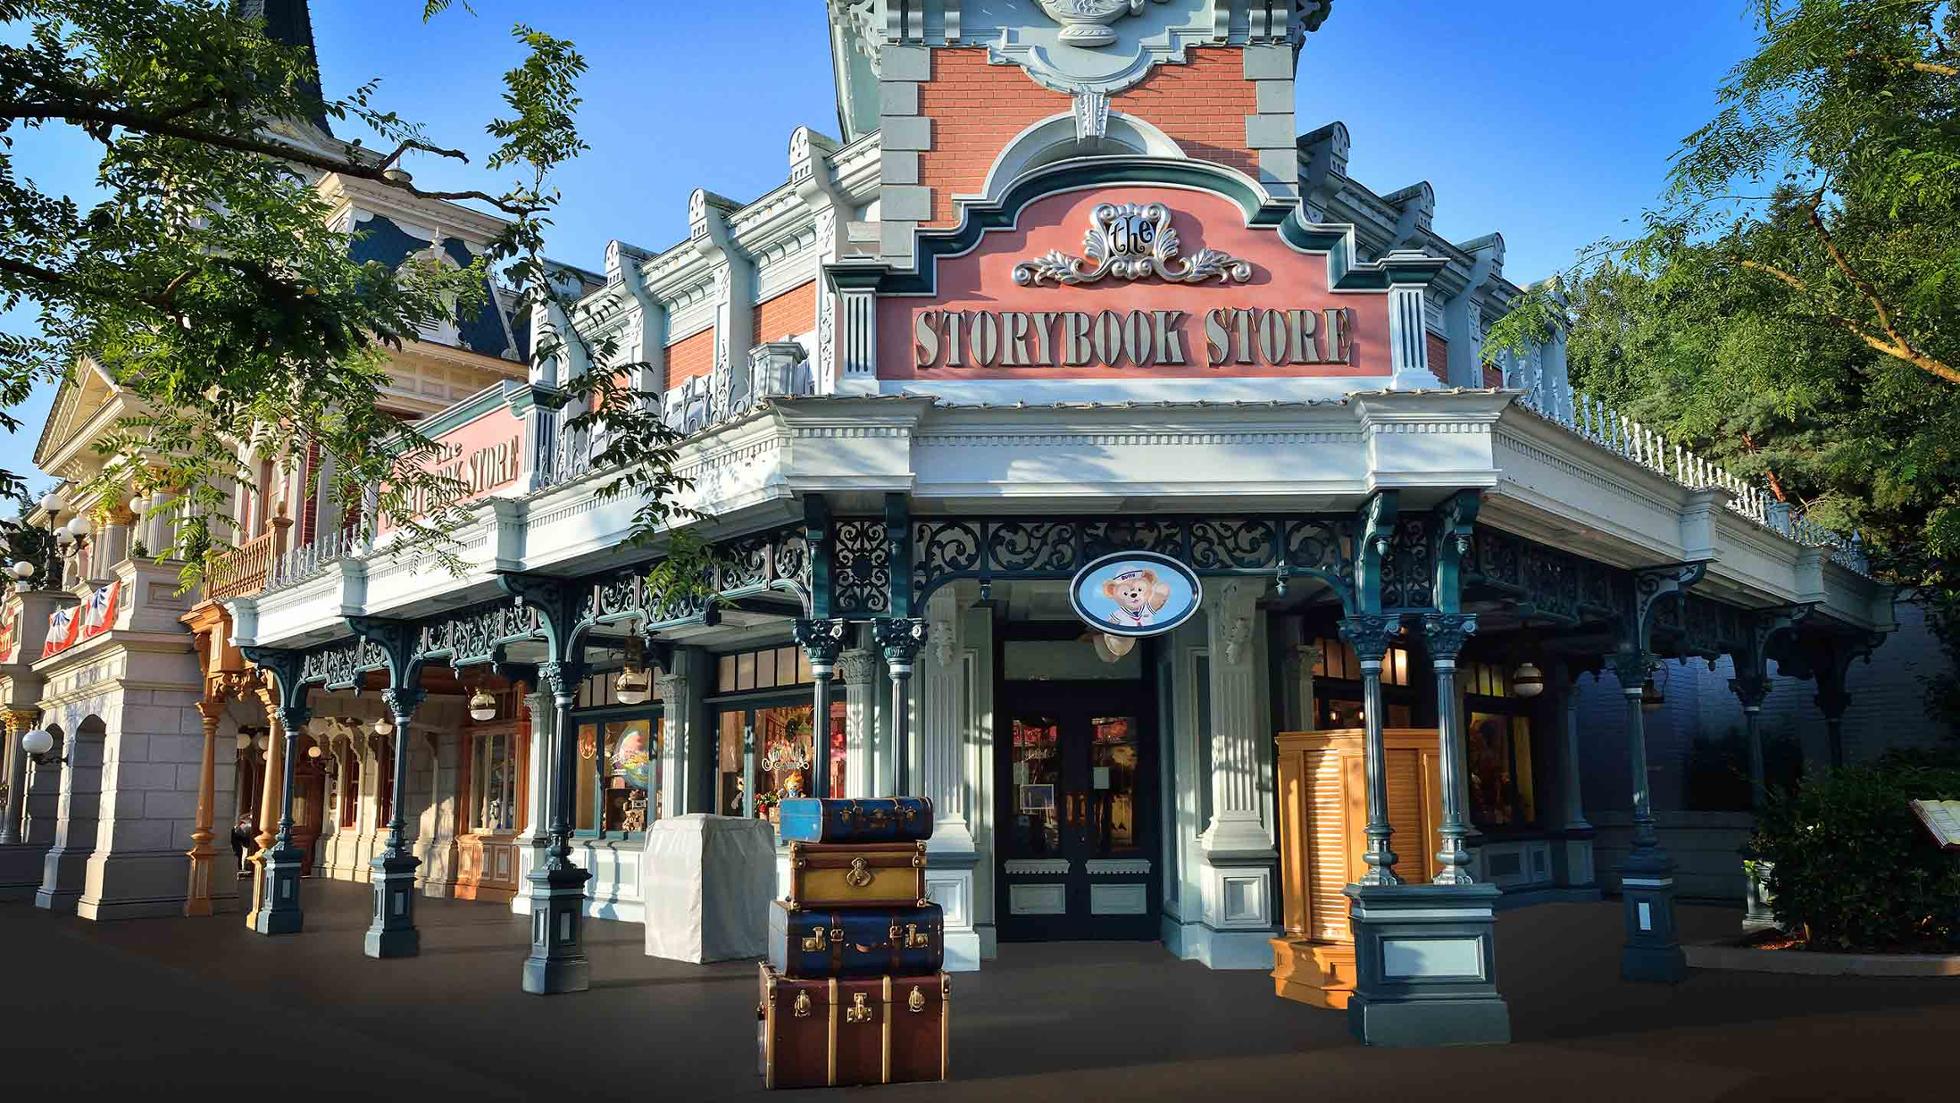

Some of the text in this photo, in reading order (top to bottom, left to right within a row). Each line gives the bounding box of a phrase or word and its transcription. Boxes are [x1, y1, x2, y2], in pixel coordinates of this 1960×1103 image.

[1111, 214, 1153, 256] the
[915, 306, 1352, 369] STORYBOOK STORE
[468, 435, 519, 496] STORE
